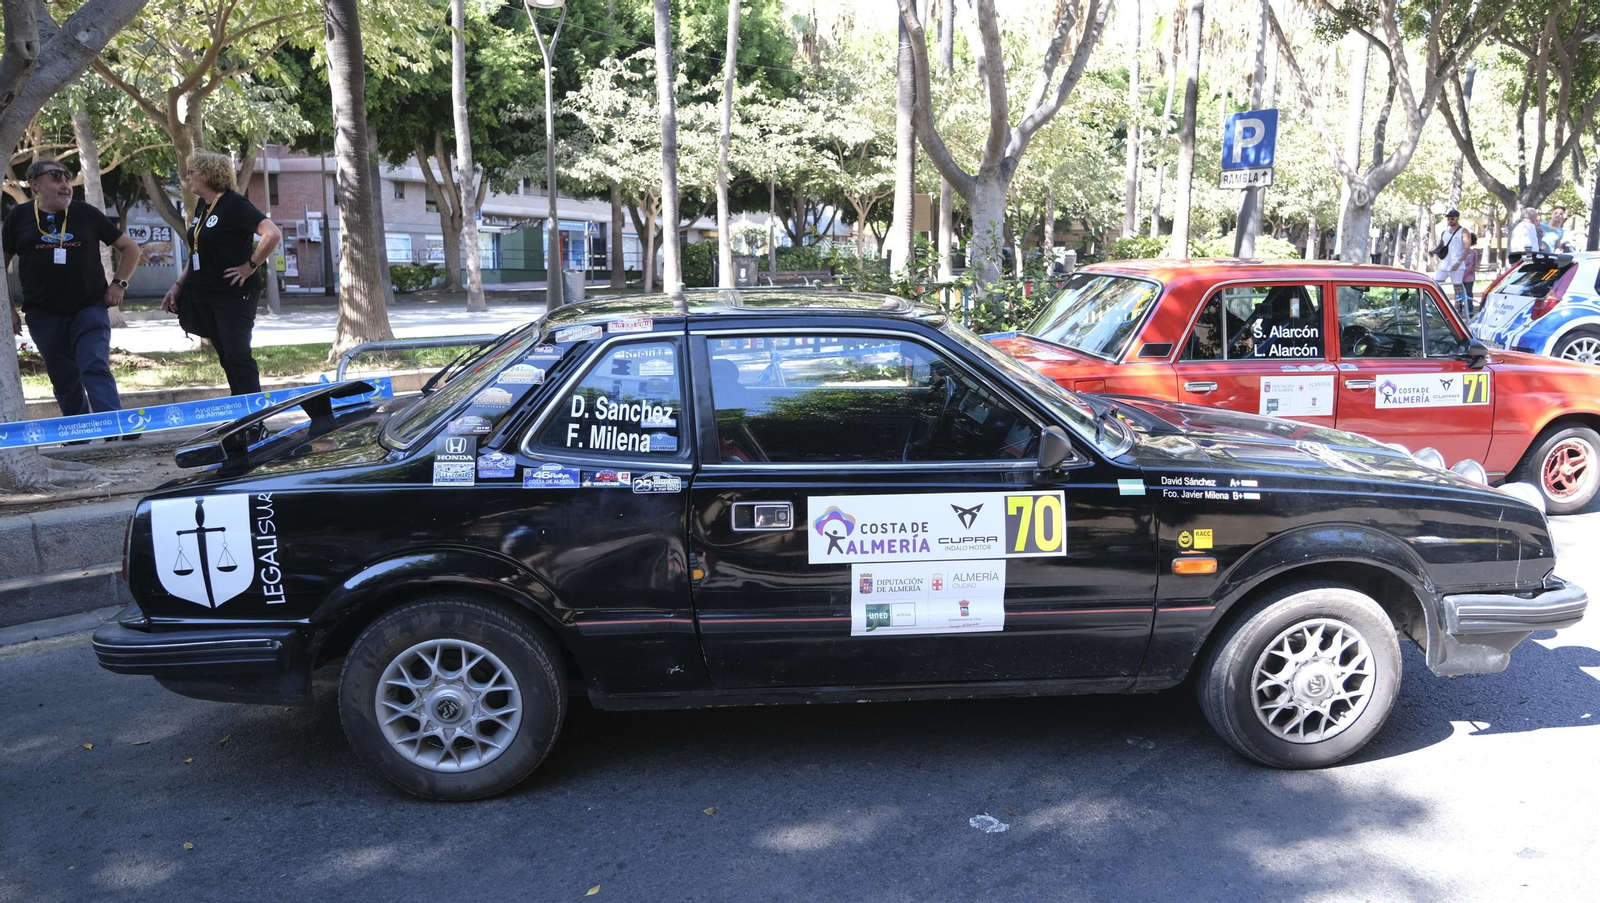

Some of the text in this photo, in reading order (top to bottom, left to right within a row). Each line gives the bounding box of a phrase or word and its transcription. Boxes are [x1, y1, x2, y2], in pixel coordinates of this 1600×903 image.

[1232, 118, 1265, 163] P
[1223, 172, 1259, 184] RAMBLA
[1253, 325, 1318, 338] S. Alarcón
[1254, 344, 1318, 356] L. Alarcón
[1464, 374, 1488, 403] 71
[1392, 394, 1430, 404] ALMERÍA
[195, 402, 242, 414] Ayuntamiento
[571, 395, 673, 424] D. Sanchez
[58, 419, 112, 431] Ayuntamiento
[566, 423, 650, 452] F. Milena
[1161, 476, 1240, 487] David Sánchez A+
[1163, 489, 1244, 500] Fco. Javier Milena B+
[860, 522, 928, 534] COSTA DE
[1007, 495, 1062, 552] 70
[846, 534, 930, 555] ALMERÍA
[938, 536, 998, 544] CUPRA
[256, 492, 286, 604] LEGALISUR
[876, 577, 923, 586] DIPUTACIÓN
[953, 571, 999, 581] ALMERÍA
